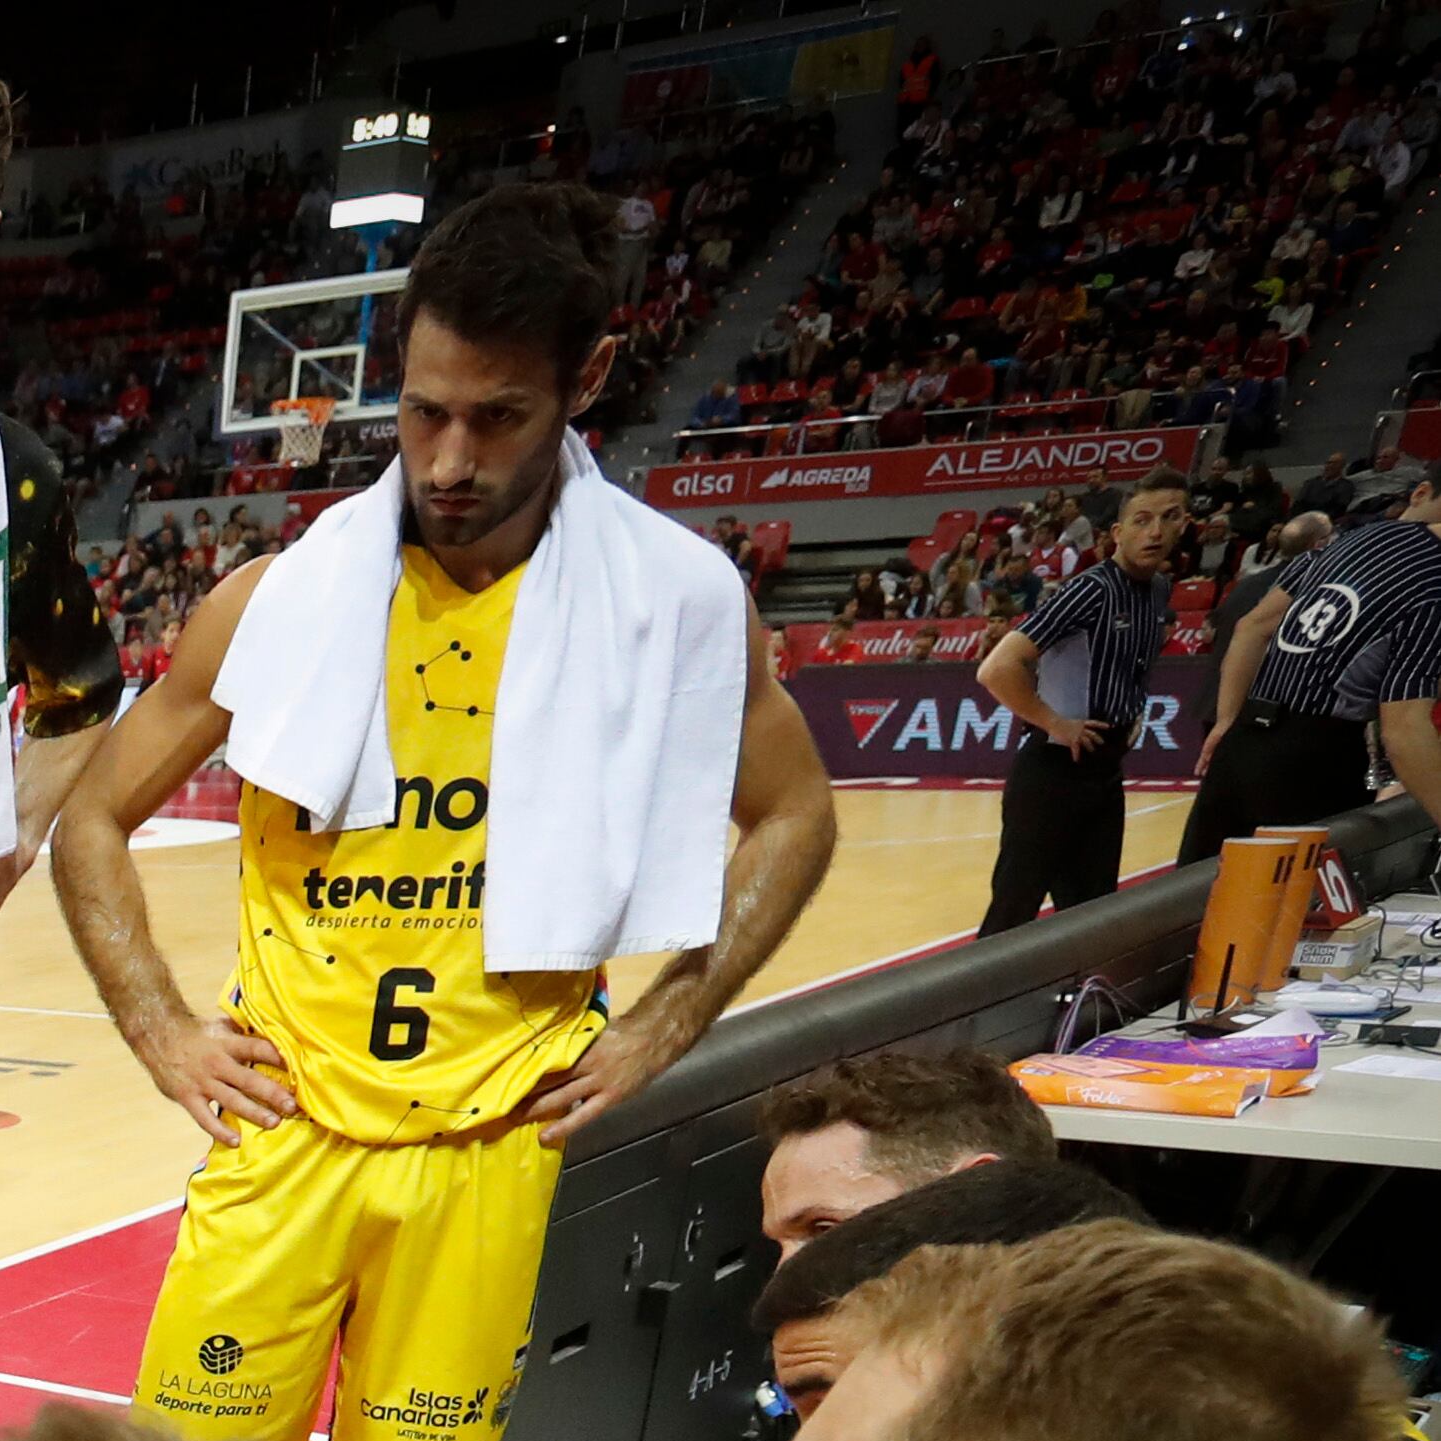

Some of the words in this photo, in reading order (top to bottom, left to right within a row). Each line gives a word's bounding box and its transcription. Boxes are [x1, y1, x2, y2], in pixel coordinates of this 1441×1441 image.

[925, 436, 1165, 478] ALEJANDRO
[672, 471, 733, 498] alsa
[788, 466, 871, 486] AGREDA
[1298, 597, 1338, 643] 43
[892, 696, 1181, 752] AMR
[304, 860, 485, 910] tenerif
[306, 914, 391, 931] despierta
[402, 913, 485, 931] emocio
[369, 966, 436, 1062] 6
[158, 1368, 182, 1390] LA
[187, 1374, 273, 1401] LAGUNA
[408, 1386, 464, 1412] Islas
[154, 1390, 214, 1416] deporte
[215, 1402, 248, 1418] para
[361, 1396, 461, 1429] Canarias
